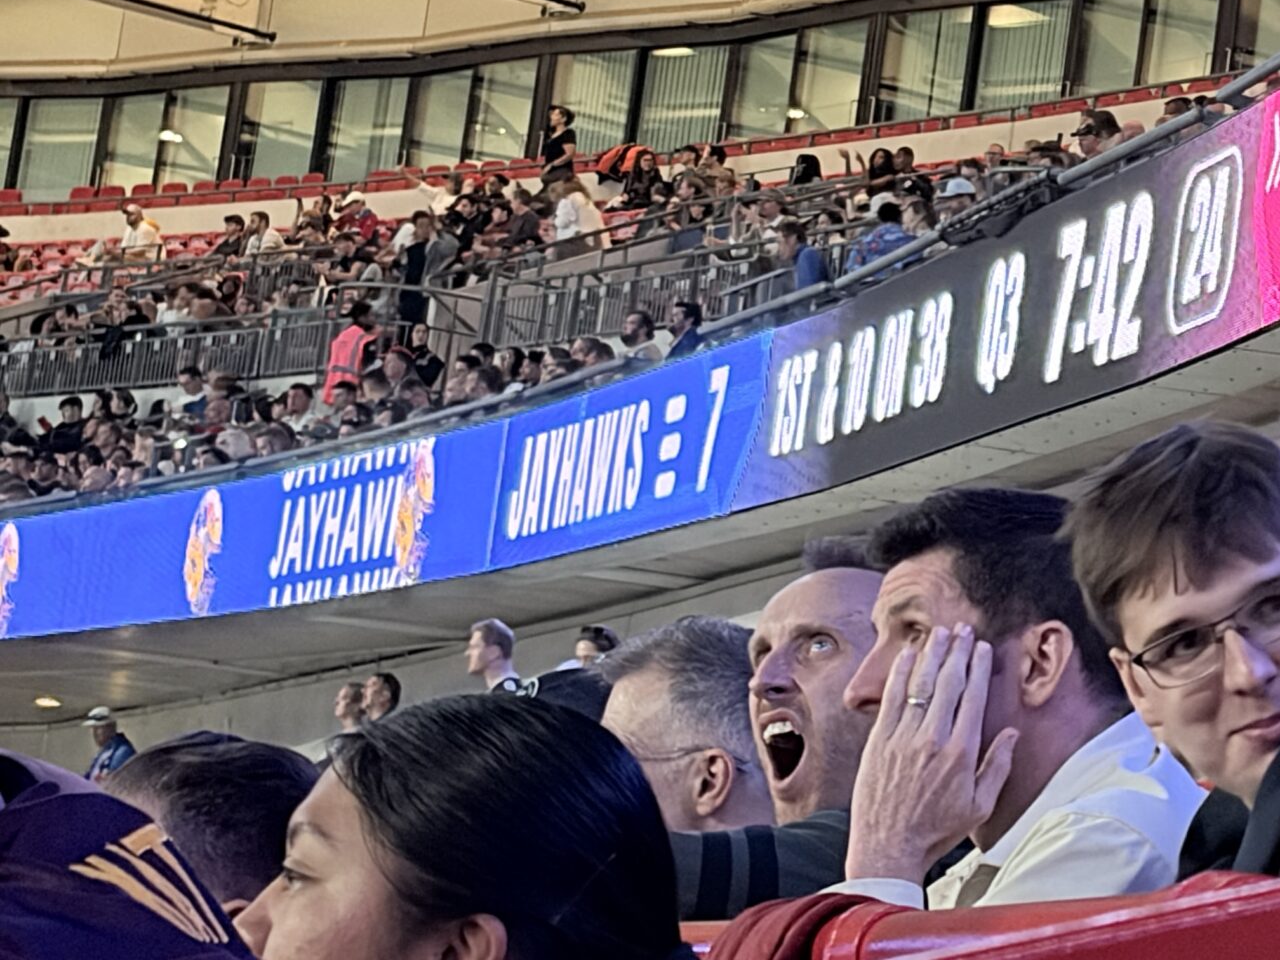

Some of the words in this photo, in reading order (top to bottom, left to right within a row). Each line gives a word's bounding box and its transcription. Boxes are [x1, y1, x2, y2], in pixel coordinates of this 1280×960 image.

[769, 349, 819, 457] 1ST
[816, 341, 843, 445] &
[842, 326, 876, 435] 10
[873, 309, 914, 423] ON
[910, 291, 953, 408] 38
[977, 251, 1026, 394] Q3
[1044, 190, 1154, 383] 7:42
[1180, 164, 1232, 306] 24
[507, 399, 650, 540] JAYHAWKS
[697, 365, 731, 492] 7
